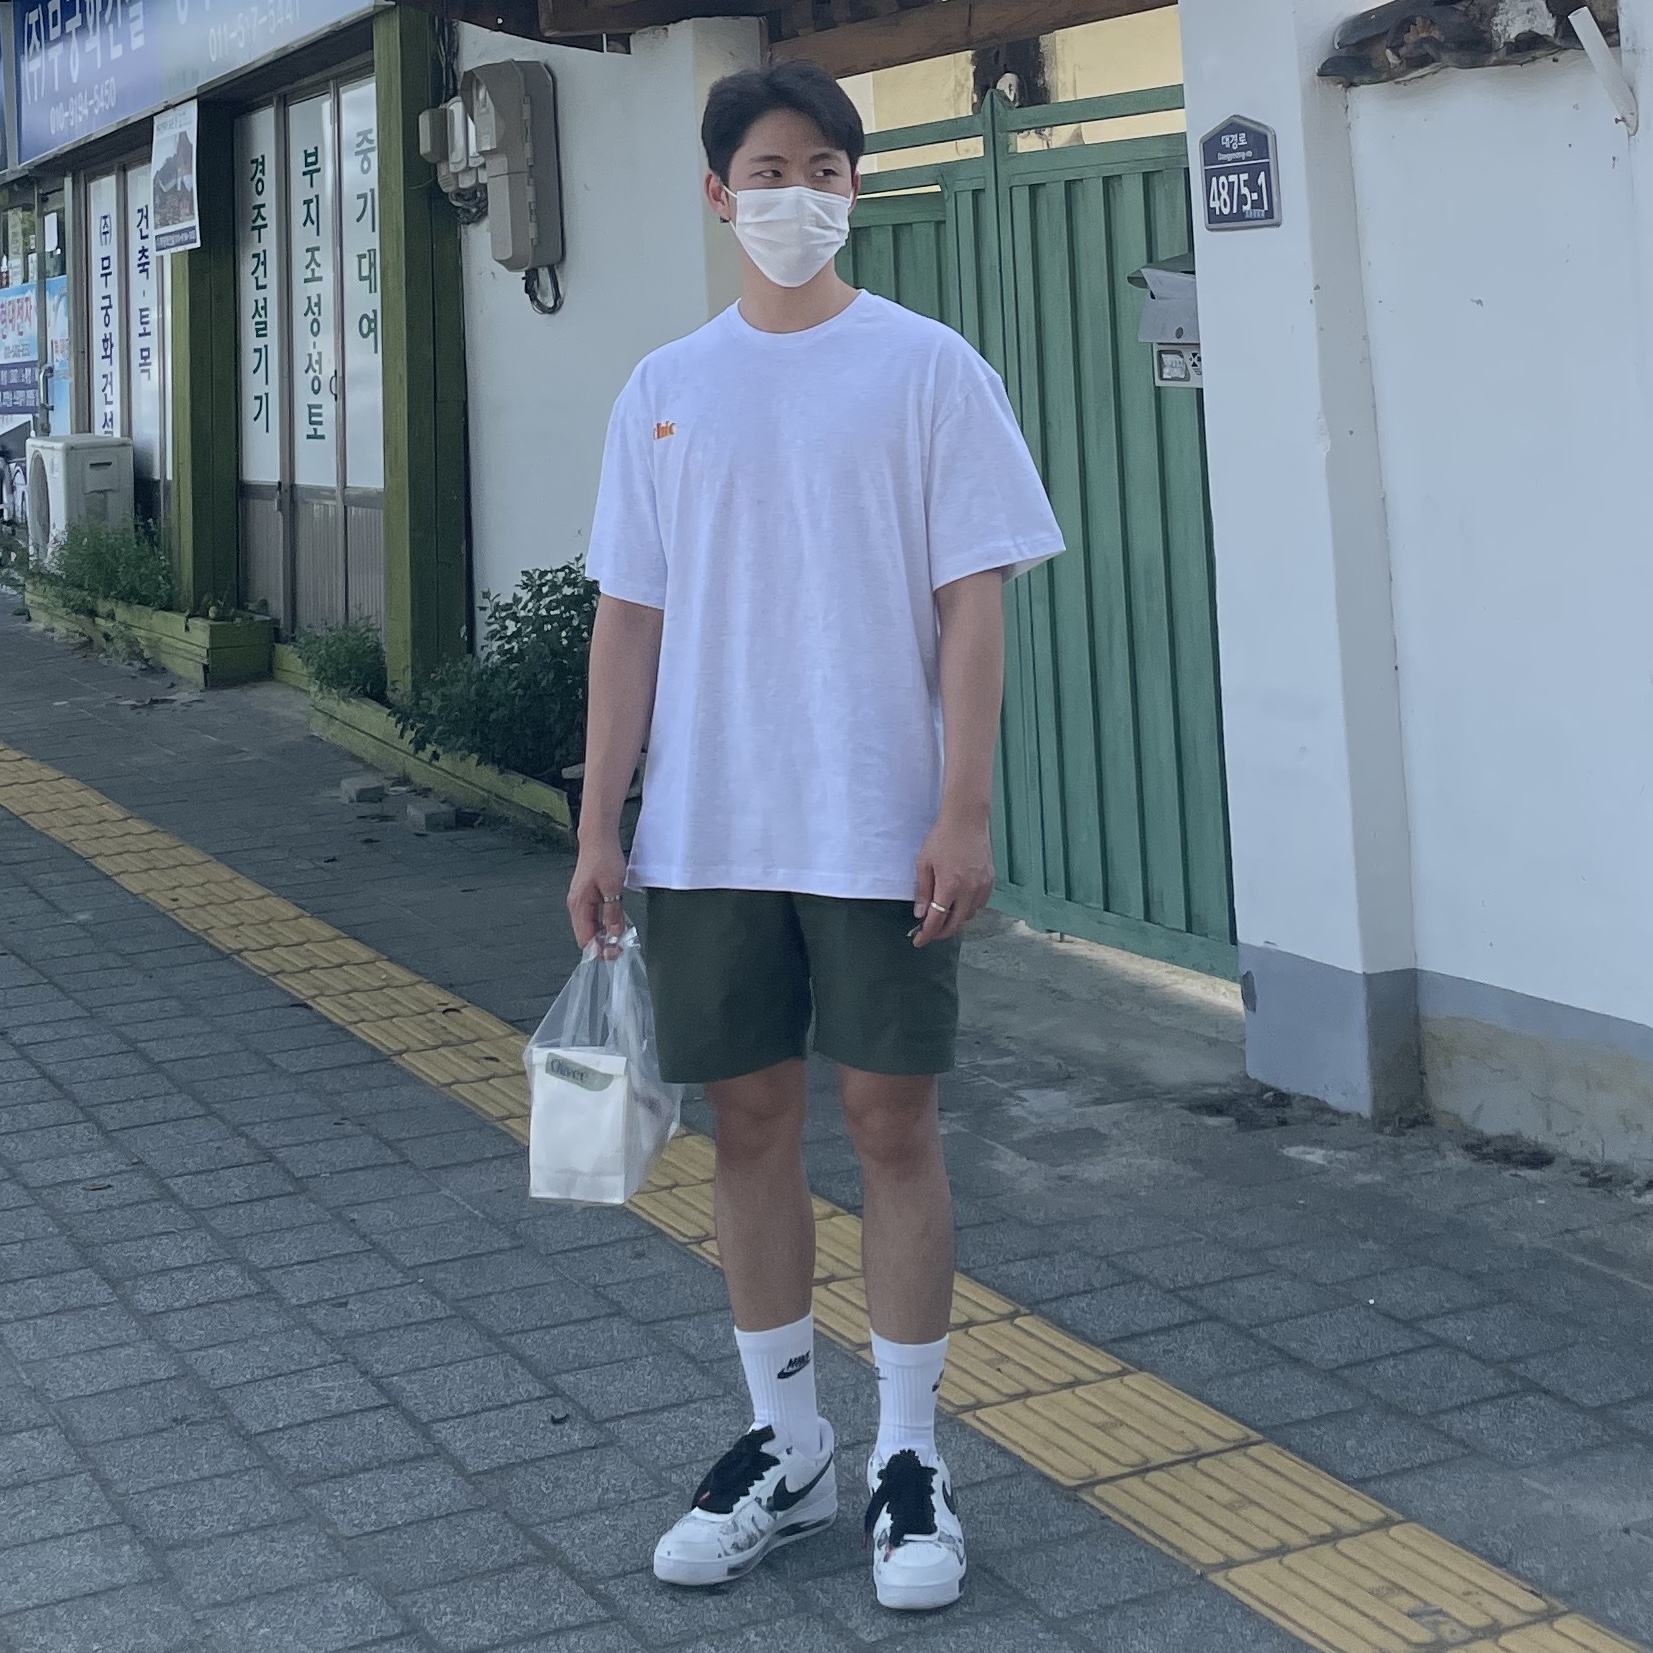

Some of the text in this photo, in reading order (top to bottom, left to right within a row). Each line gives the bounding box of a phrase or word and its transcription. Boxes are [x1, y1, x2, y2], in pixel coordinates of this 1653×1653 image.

[250, 154, 271, 434] 경주건설기기
[354, 128, 379, 355] 중기대여
[1209, 170, 1269, 215] 4875-1
